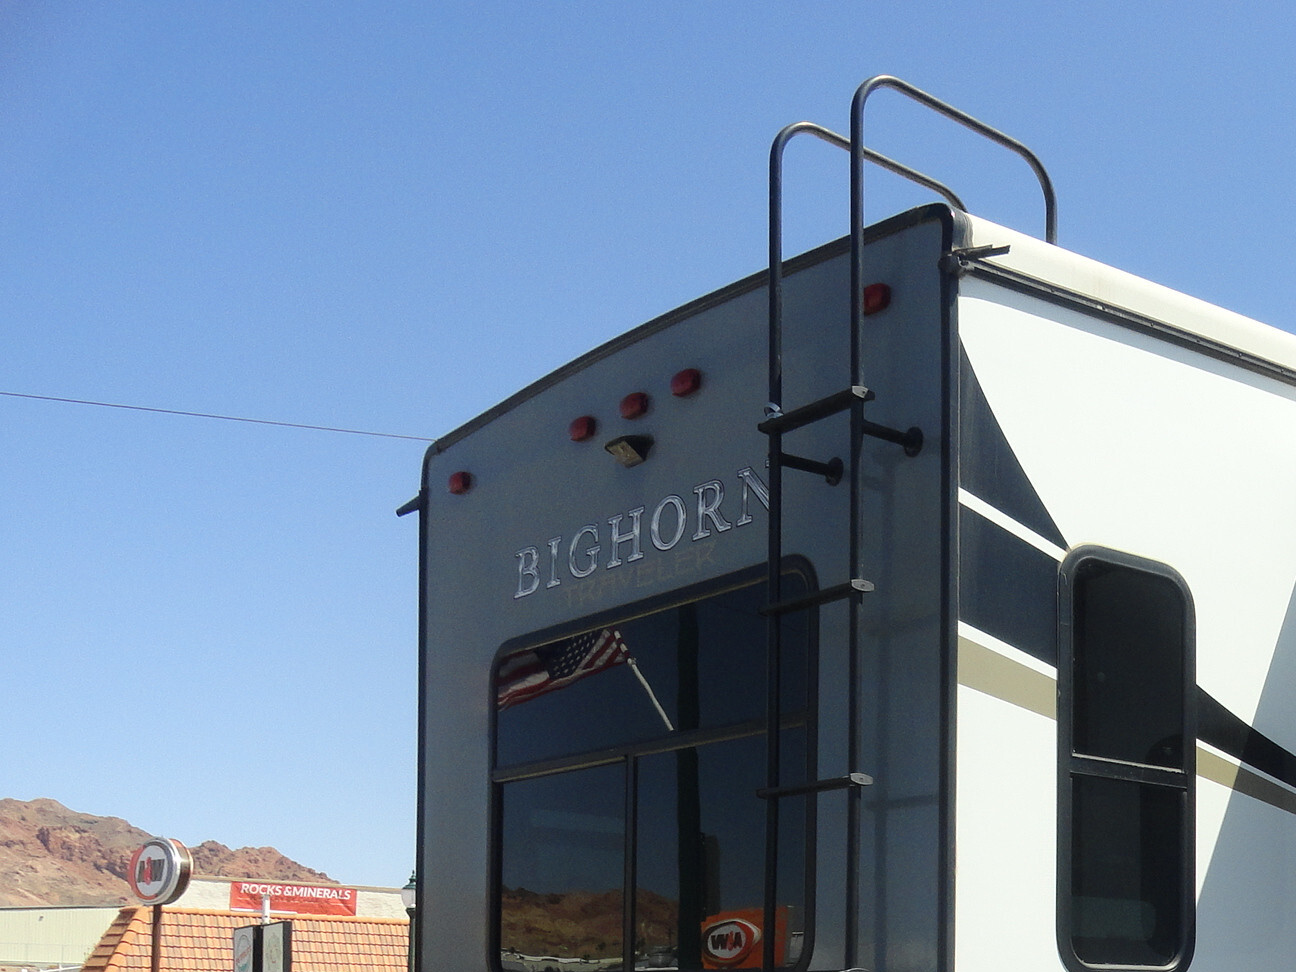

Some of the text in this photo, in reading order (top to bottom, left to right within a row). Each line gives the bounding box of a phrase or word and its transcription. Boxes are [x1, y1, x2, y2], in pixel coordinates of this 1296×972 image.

[513, 460, 770, 600] BIGHORN
[563, 540, 717, 607] TRAVELER
[241, 884, 283, 896] ROCKS
